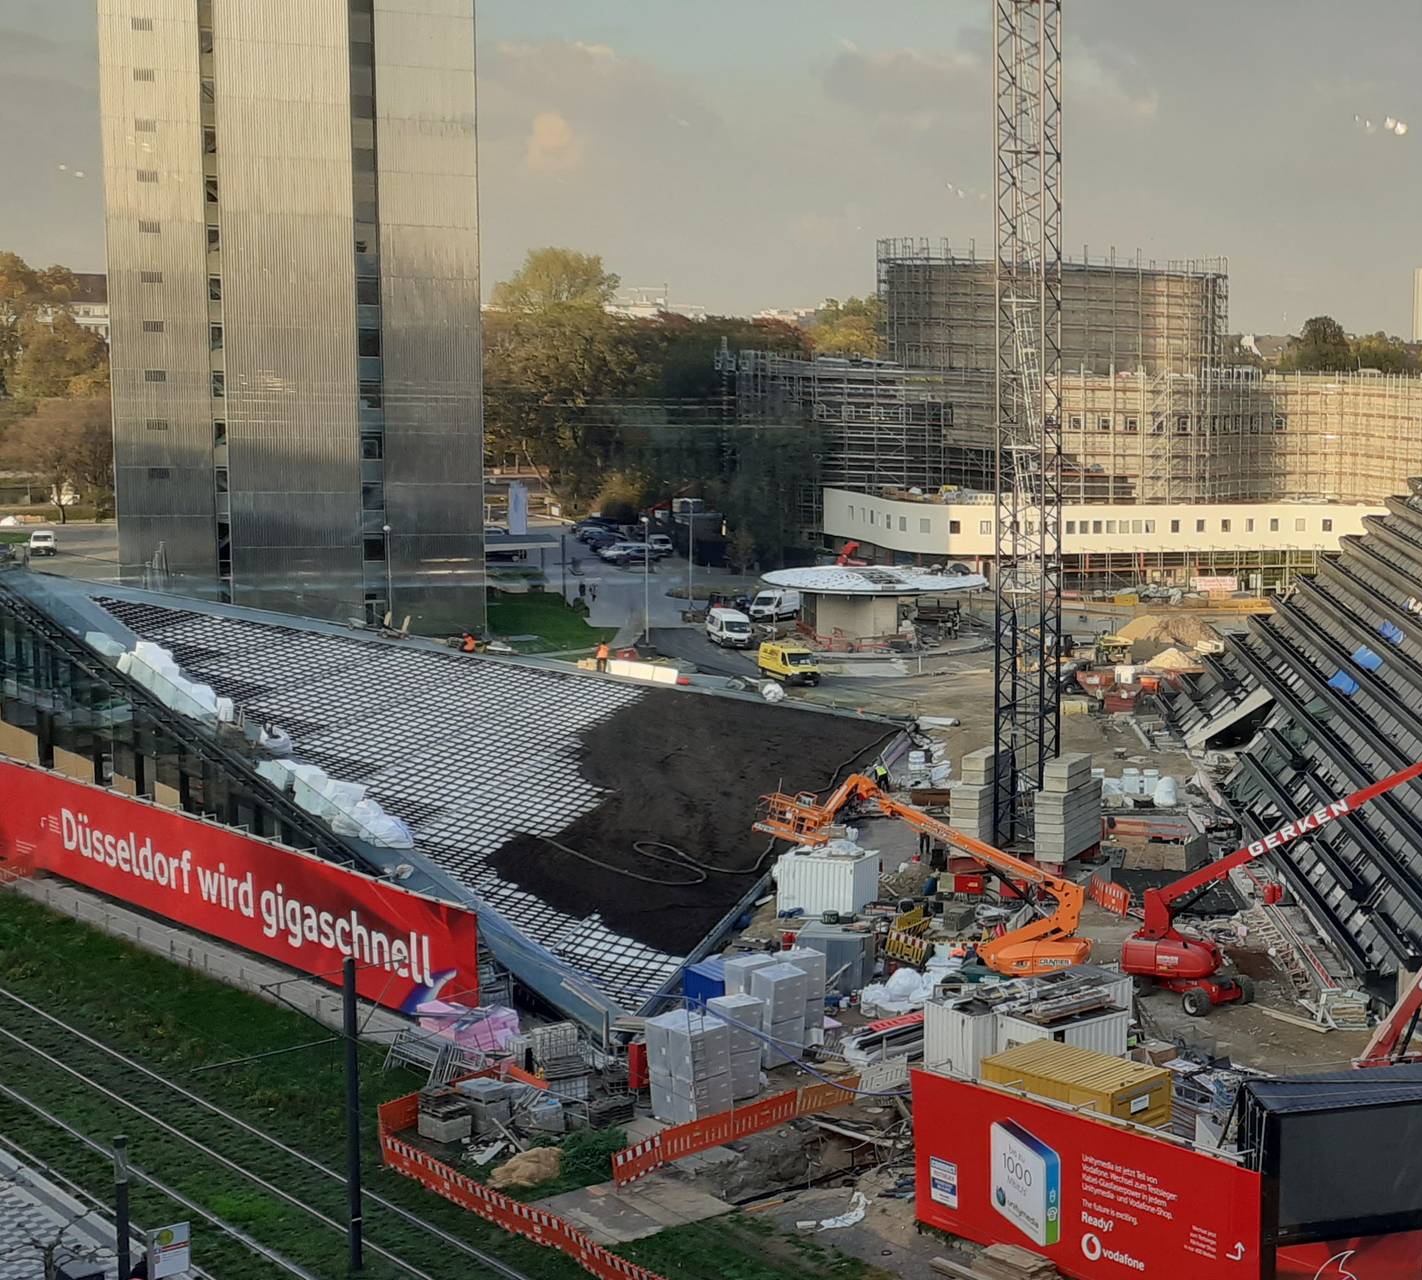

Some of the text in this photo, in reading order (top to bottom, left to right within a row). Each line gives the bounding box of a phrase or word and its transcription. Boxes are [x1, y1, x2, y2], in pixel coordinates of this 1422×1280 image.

[1248, 798, 1349, 857] GERKEN
[61, 807, 434, 988] Düsseldorf wird gigaschnell
[1002, 1152, 1032, 1187] 1000
[1146, 1175, 1158, 1185] von
[1081, 1198, 1092, 1209] The
[1093, 1202, 1110, 1215] future
[1081, 1211, 1114, 1232] Ready?
[1102, 1247, 1145, 1272] vodafone
